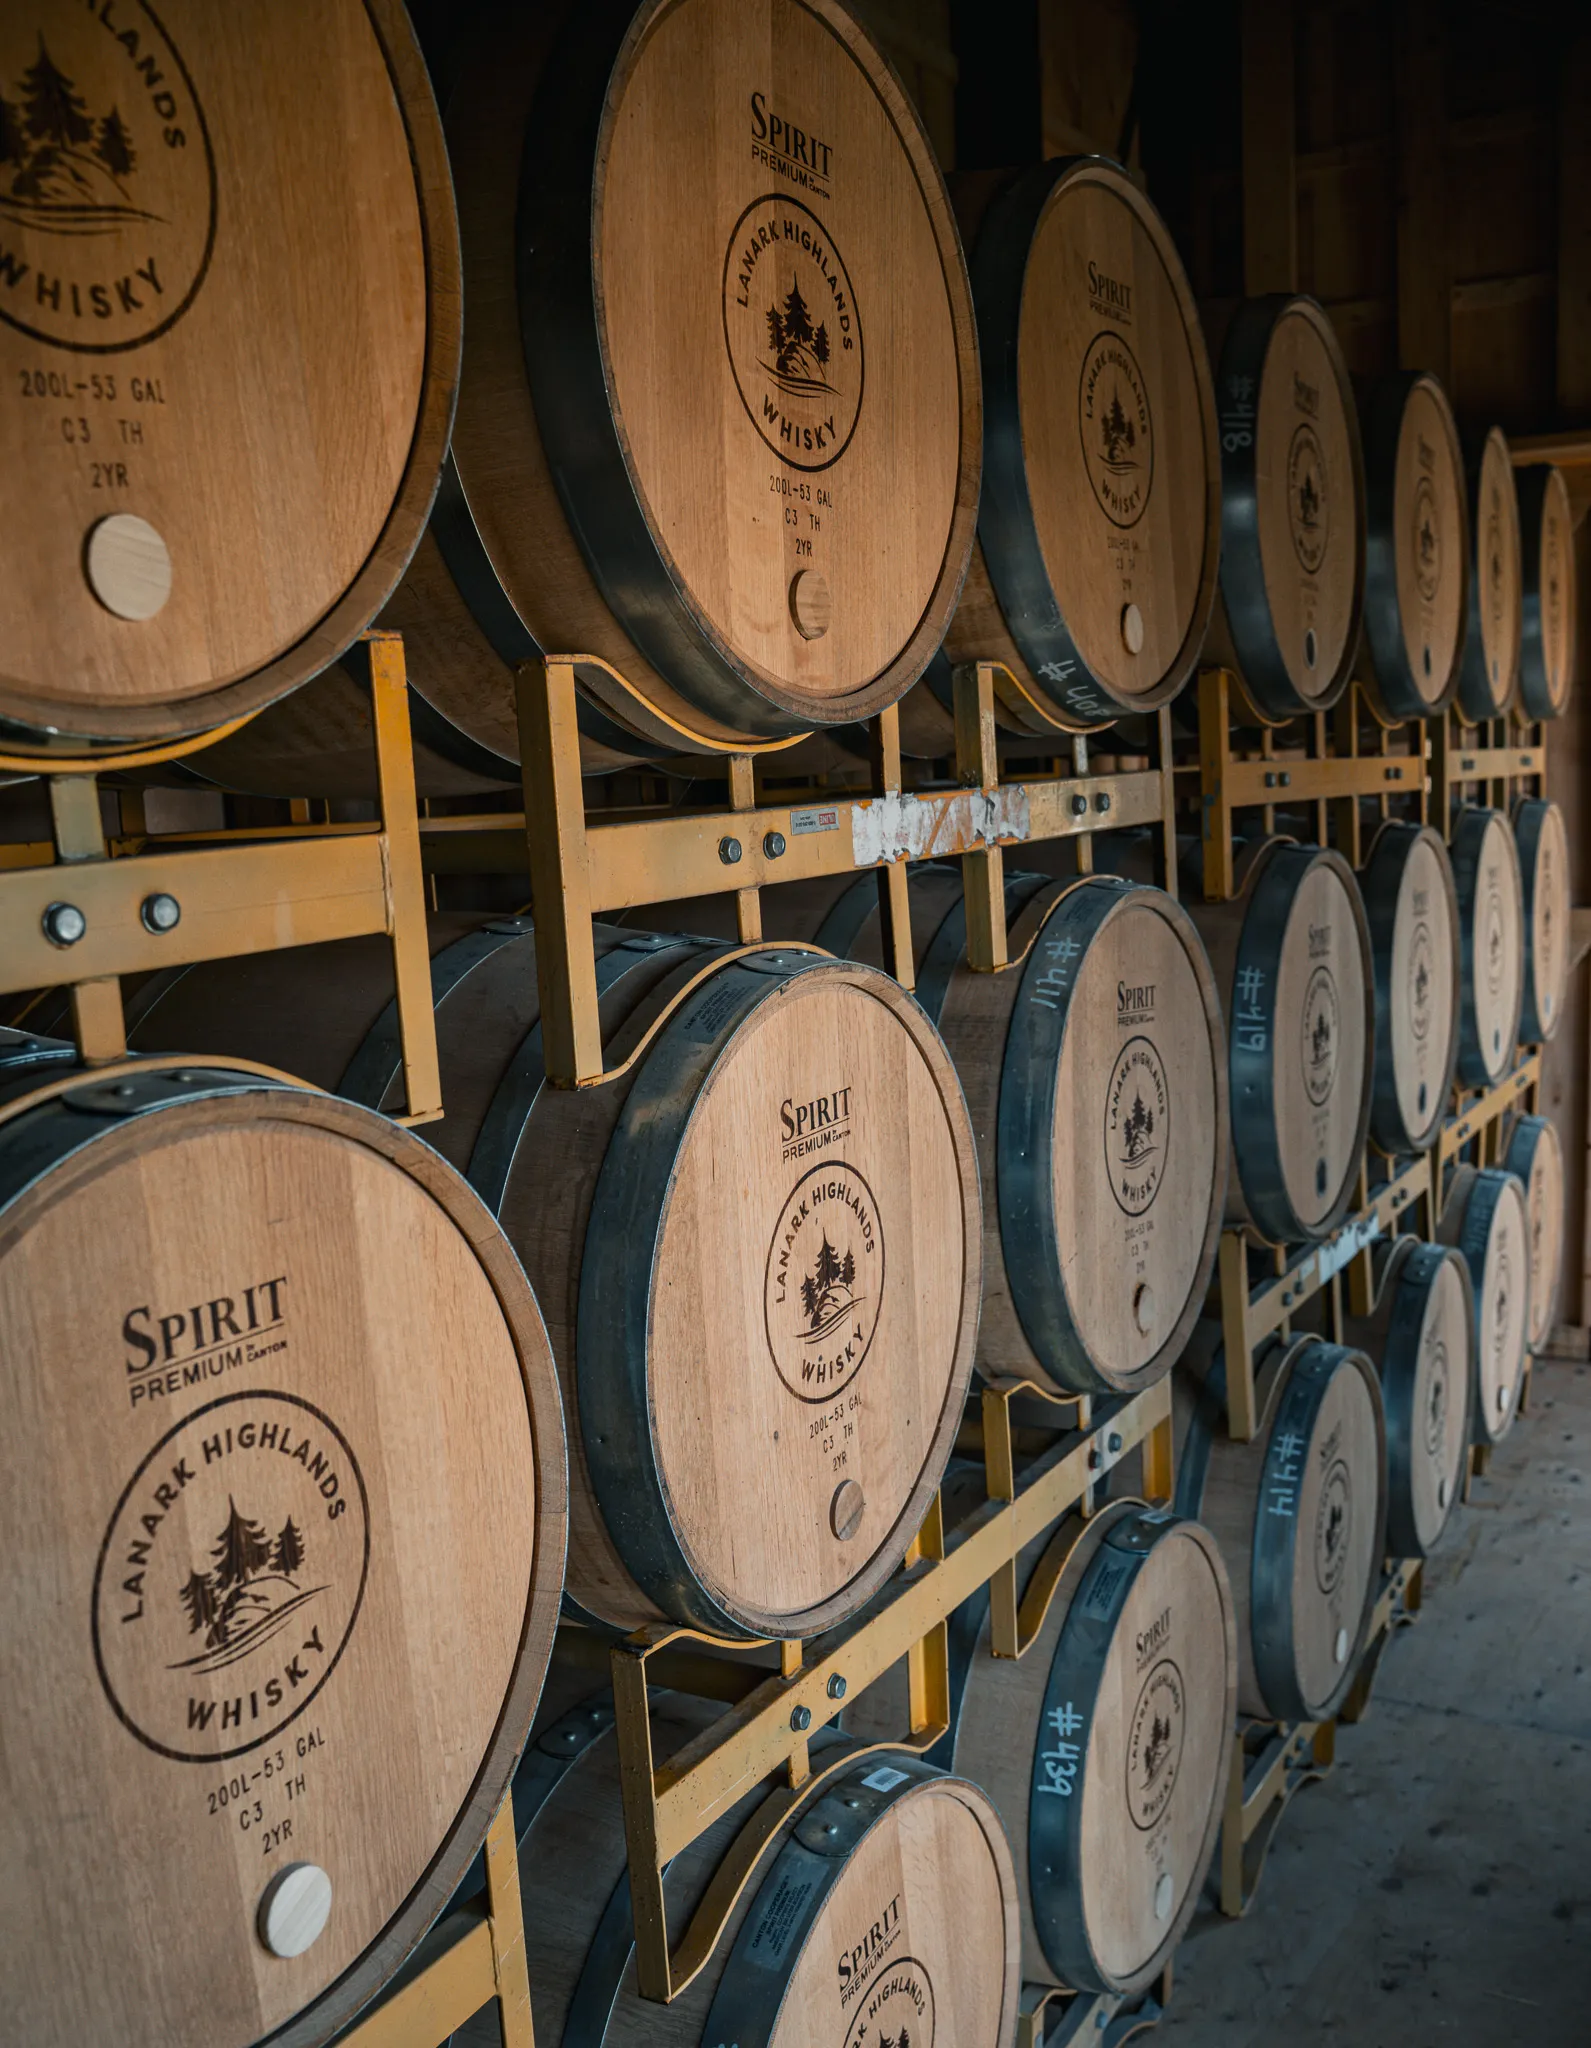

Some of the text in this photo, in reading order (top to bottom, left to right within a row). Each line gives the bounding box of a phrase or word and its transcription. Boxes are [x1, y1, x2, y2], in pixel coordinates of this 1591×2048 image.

[751, 91, 833, 178] SPIRIT
[751, 144, 808, 189] PREMIUM
[0, 244, 164, 319] WHISKY
[736, 219, 853, 351] LANARK HIGHLANDS
[19, 369, 165, 405] 200L-53 GAL
[60, 416, 144, 445] C3 TH
[763, 394, 837, 451] WHISKY
[89, 462, 129, 489] 2YR
[769, 475, 833, 509] 200L-53 GAL
[1102, 478, 1141, 514] WHISKY
[784, 507, 822, 533] C3 TH
[794, 537, 813, 558] 2YR
[1117, 980, 1157, 1012] SPIRIT
[1237, 965, 1267, 1052] #419
[780, 1086, 852, 1143] SPIRIT
[782, 1131, 832, 1165] PREMIUM
[1121, 1165, 1157, 1202] WHISKY
[776, 1181, 875, 1304] LANARK HIGHLANDS
[122, 1276, 288, 1376] SPIRIT
[801, 1323, 864, 1384] WHISKY
[130, 1348, 243, 1408] PREMIUM
[247, 1340, 288, 1363] CANTON
[809, 1391, 863, 1440] 200L-53 GAL
[823, 1422, 854, 1454] C3 TH
[832, 1450, 848, 1472] 2YR
[1267, 1433, 1306, 1516] #414
[121, 1422, 347, 1624] LANARK HIGHLANDS
[187, 1624, 325, 1731] WHISKY
[208, 1726, 326, 1816] 200L-53 GAL
[1037, 1701, 1084, 1797] #439
[239, 1773, 306, 1832] C3 TH
[262, 1818, 294, 1855] 2YR
[837, 1893, 900, 1994] SPIRIT
[841, 1946, 885, 2009] PREMIUM
[868, 1976, 926, 2020] HIGHLANDS
